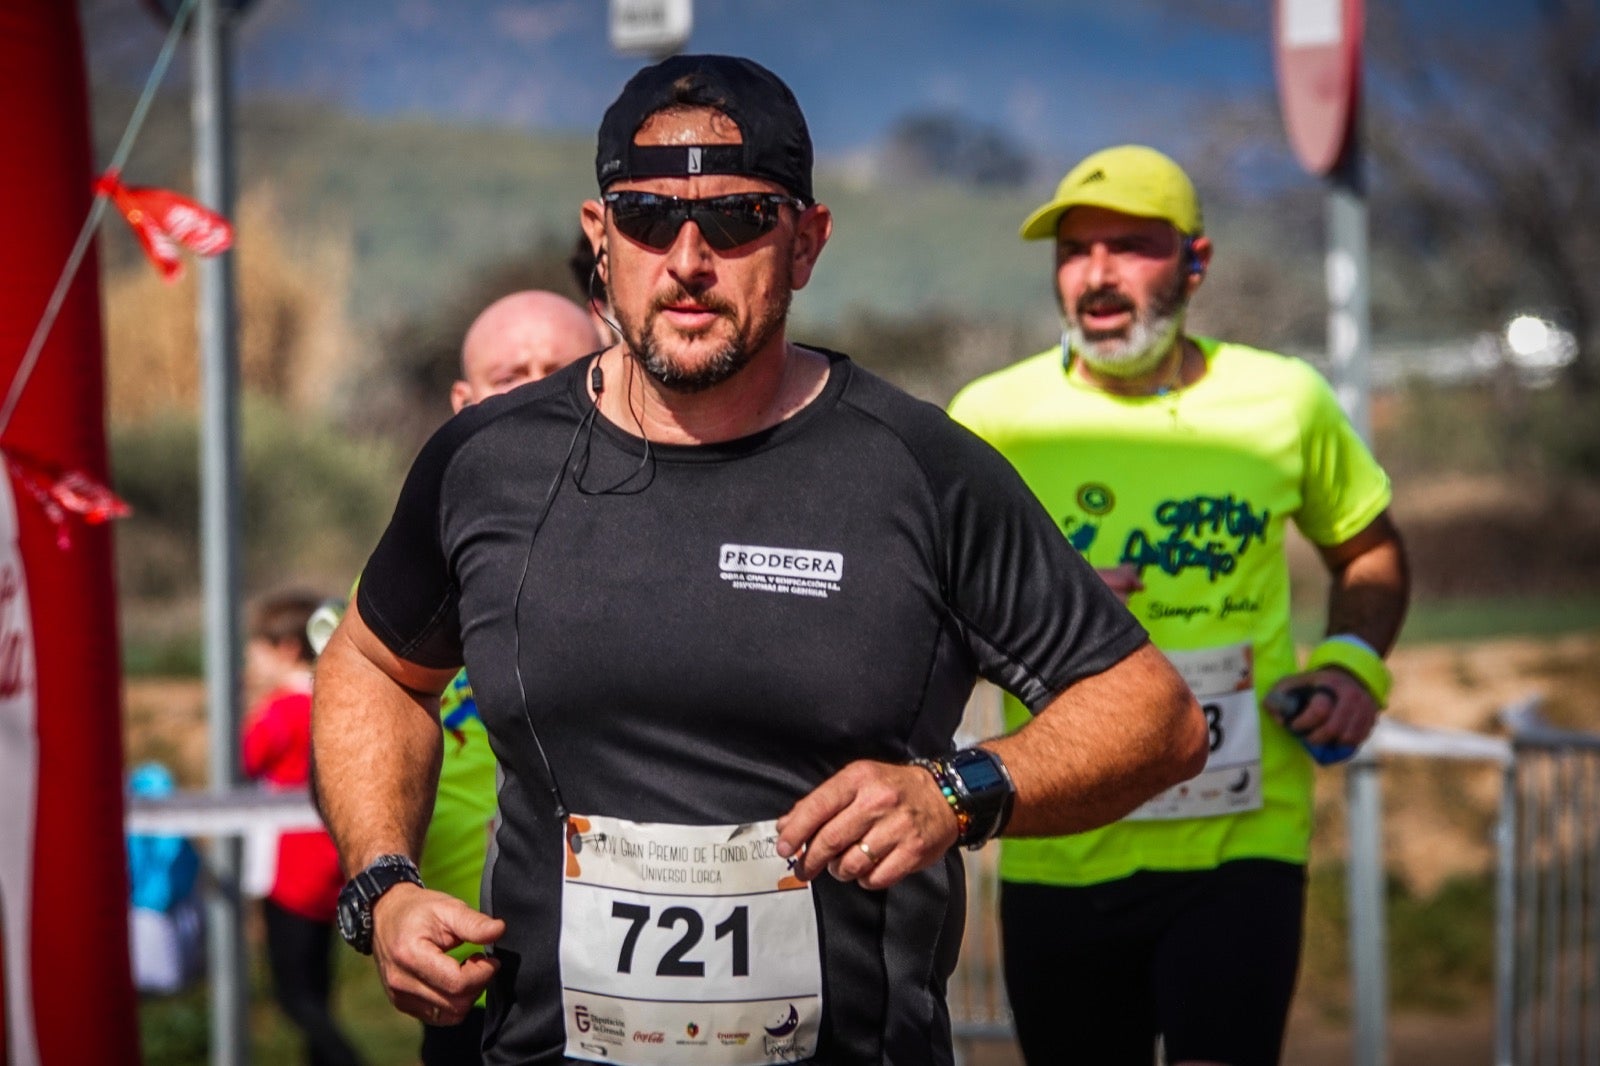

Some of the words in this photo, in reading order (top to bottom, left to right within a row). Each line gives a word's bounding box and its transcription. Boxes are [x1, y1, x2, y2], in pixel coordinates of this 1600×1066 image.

[724, 551, 837, 573] PRODEGRA
[720, 572, 745, 581] OBRA
[746, 573, 767, 583] CIVIL
[777, 584, 789, 593] EN
[620, 837, 644, 859] GRAN
[649, 841, 689, 863] PREMIO
[693, 848, 707, 863] DE
[713, 843, 748, 863] FONDO
[641, 864, 687, 883] UNIVERSO
[691, 867, 722, 884] LORCA
[611, 901, 749, 977] 721
